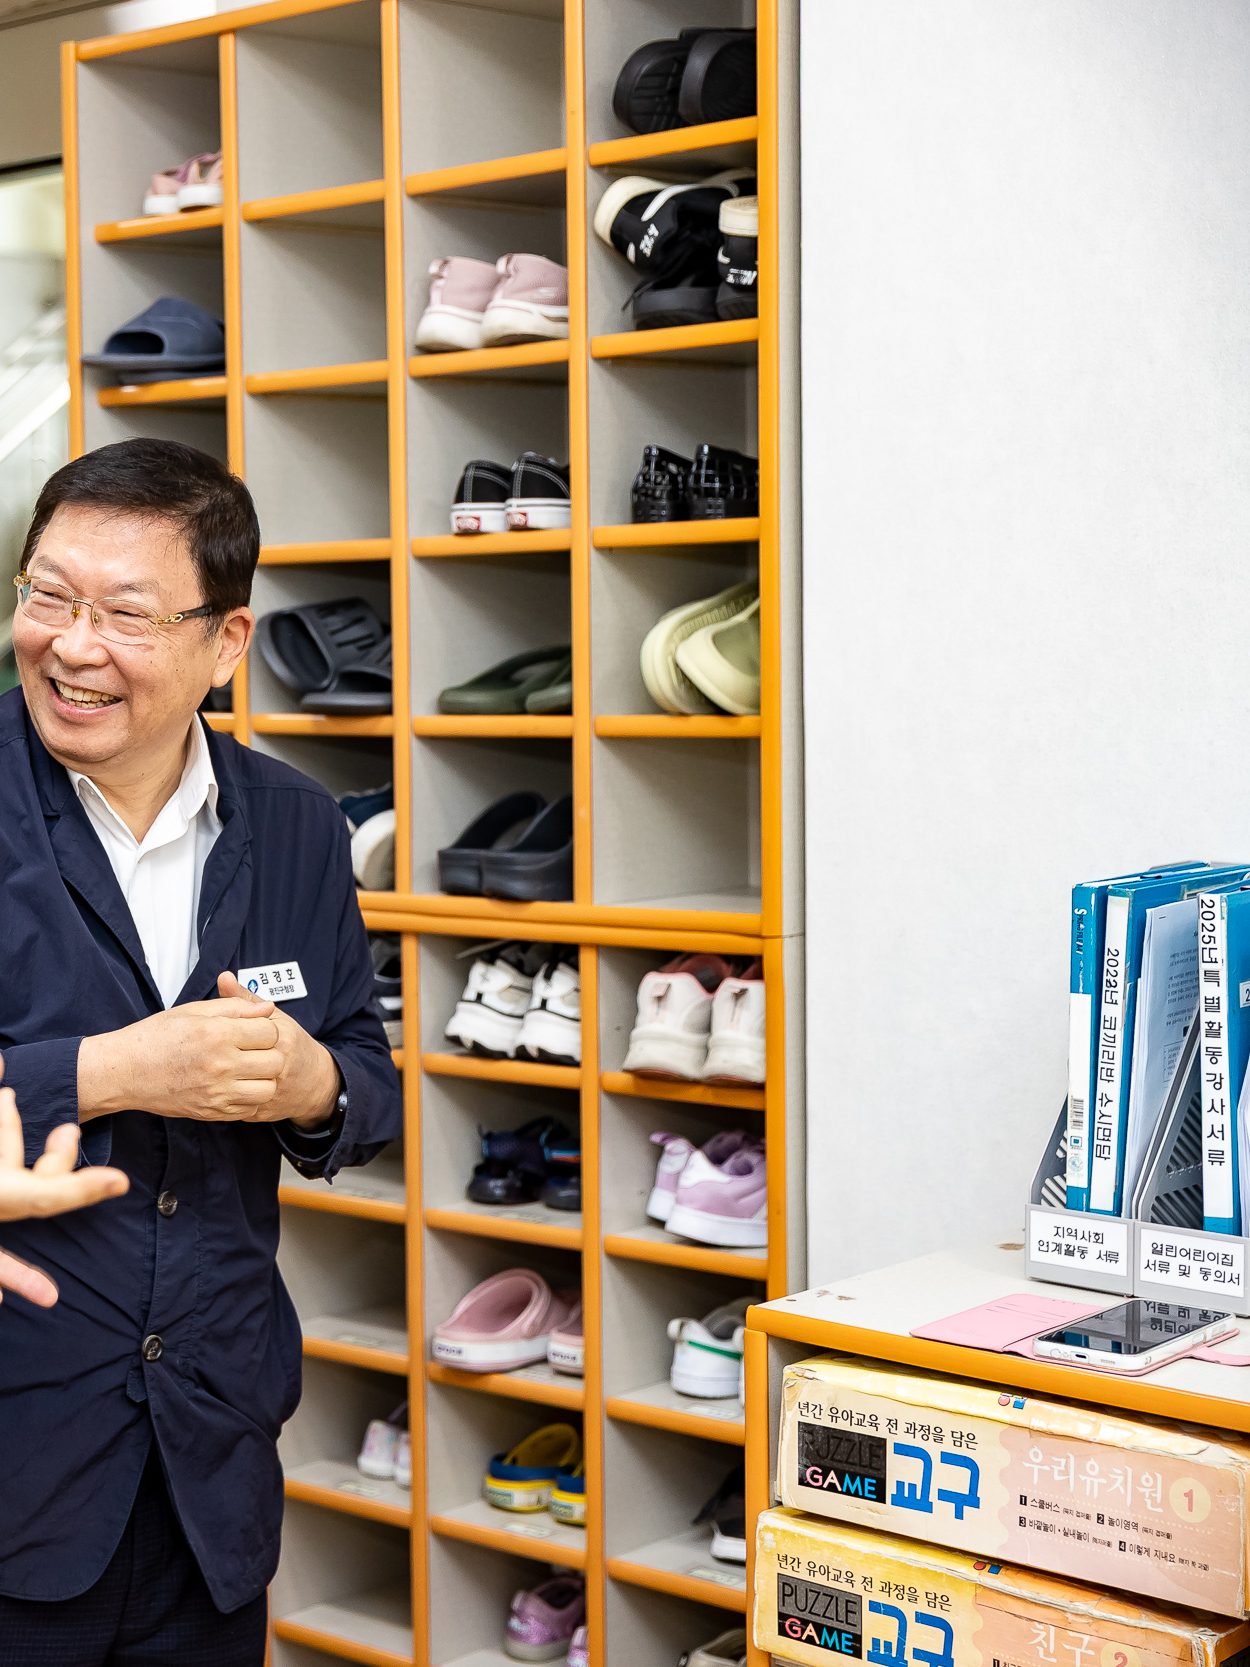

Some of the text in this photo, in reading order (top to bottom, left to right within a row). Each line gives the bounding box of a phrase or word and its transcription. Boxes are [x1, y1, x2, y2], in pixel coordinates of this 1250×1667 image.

[1200, 899, 1219, 964] 2025년
[1100, 1014, 1117, 1083] 코끼리반
[1095, 1092, 1113, 1161] 수시면담
[1037, 1239, 1120, 1264] 연계활동 서류
[1053, 1225, 1104, 1245] 지역사회
[1150, 1242, 1234, 1267] 열린어린이집
[1144, 1259, 1240, 1286] 서류 및 동의서
[797, 1401, 979, 1450] 년간 유아교육 전 과정을 담은
[805, 1466, 877, 1499] GAME
[890, 1442, 981, 1521] 교구
[1022, 1445, 1194, 1513] 우리유치원 1
[1107, 1516, 1139, 1533] 놀이영역
[1153, 1549, 1176, 1564] 지내요
[776, 1552, 953, 1613] 년간 유아교육 전 과정을 담은
[781, 1581, 858, 1628] PUZZLE
[784, 1617, 854, 1655] GAME
[867, 1599, 955, 1667] 교구
[1028, 1622, 1096, 1667] 친구
